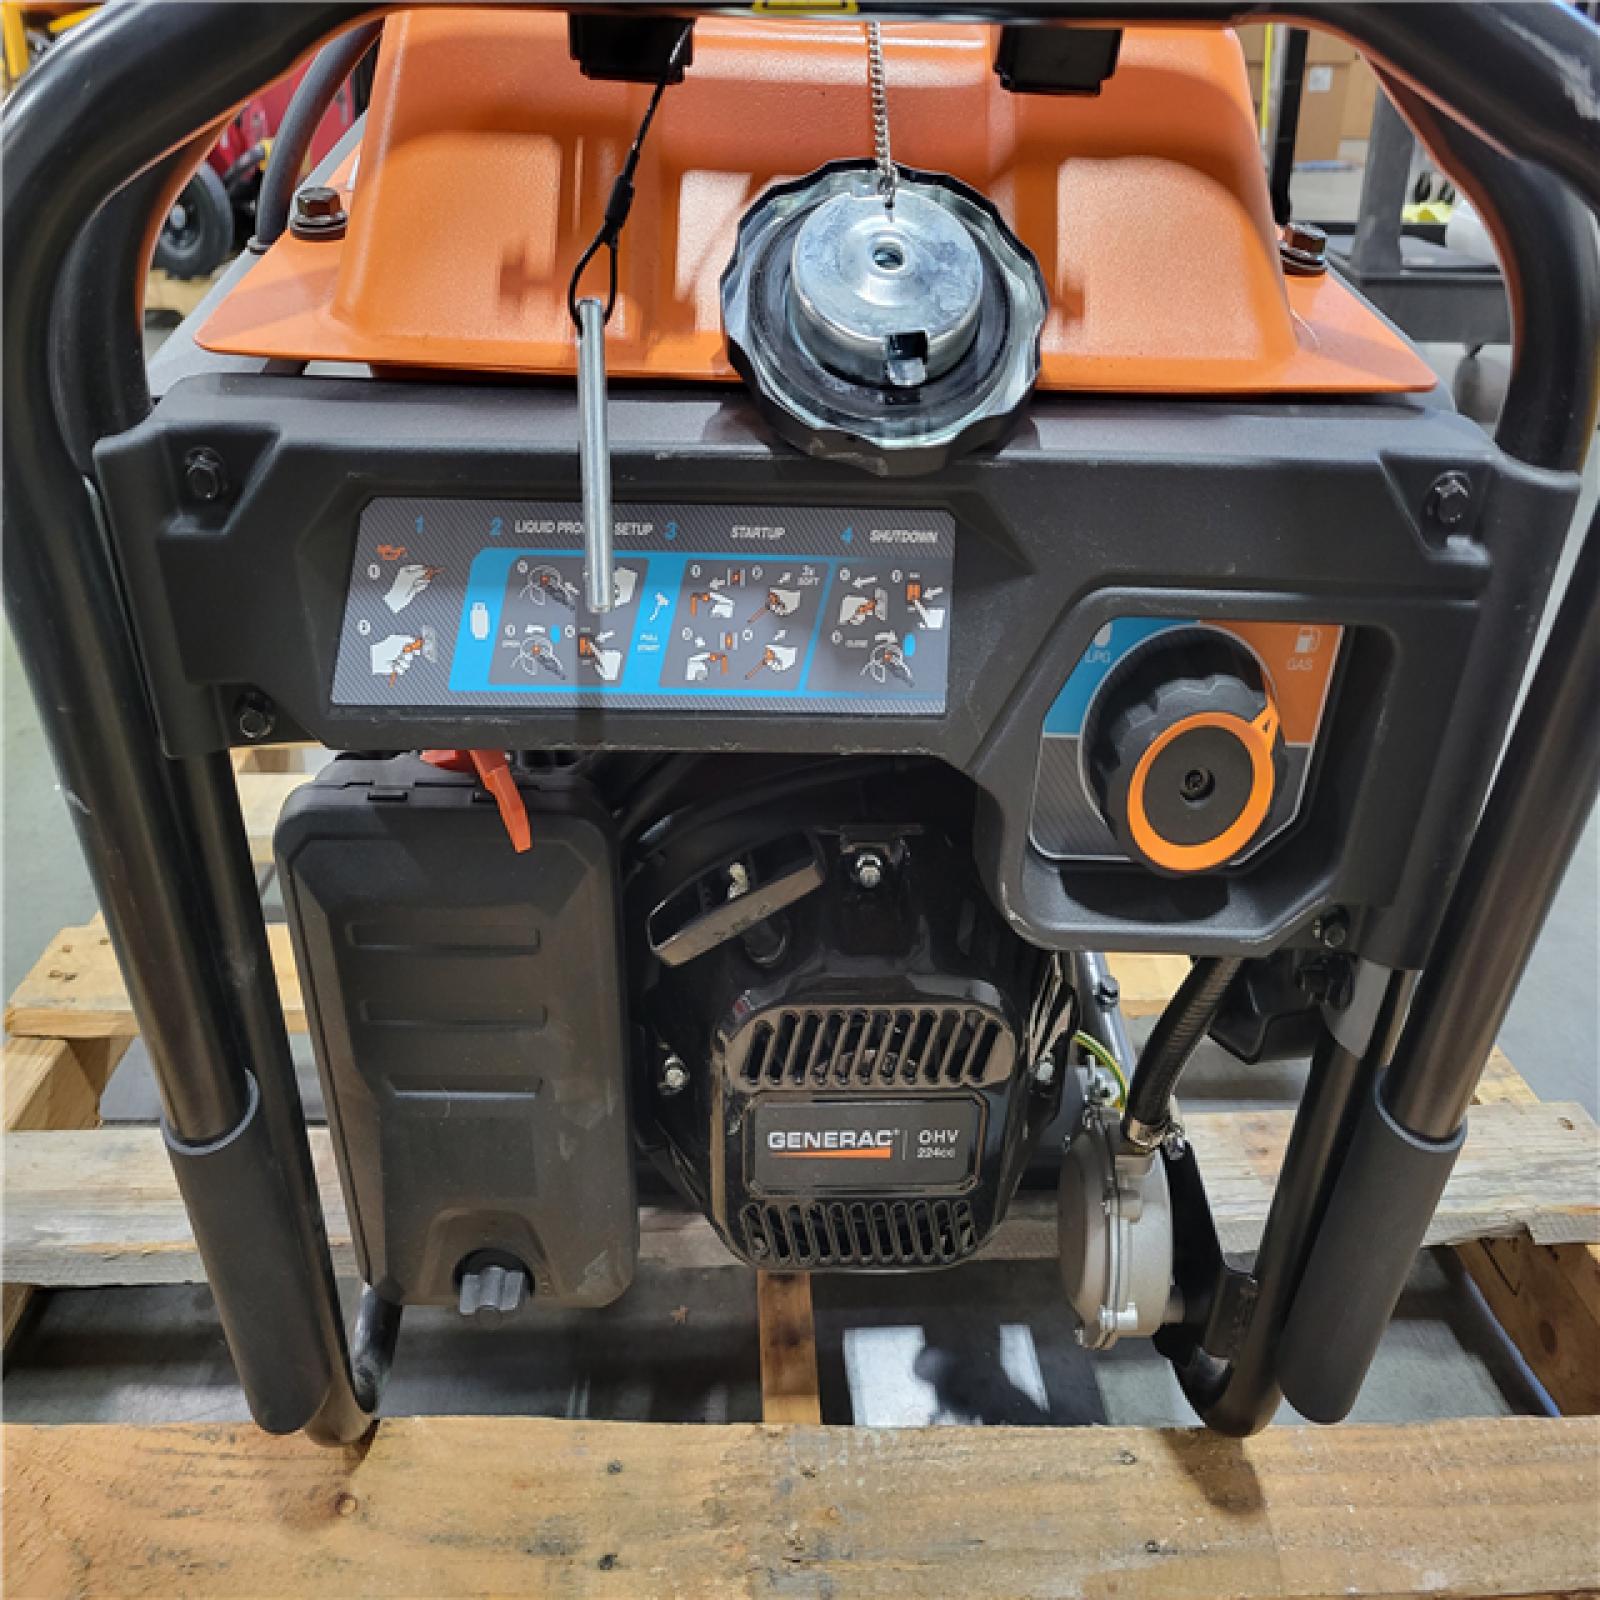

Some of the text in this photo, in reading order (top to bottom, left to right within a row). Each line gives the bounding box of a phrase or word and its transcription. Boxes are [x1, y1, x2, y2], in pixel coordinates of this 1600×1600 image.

[489, 516, 504, 537] 2
[514, 519, 556, 534] LIQUID
[614, 521, 654, 536] SETUP
[664, 521, 679, 541] 3
[730, 525, 786, 540] STARTUP
[840, 526, 854, 544] 4
[869, 529, 938, 544] SHUTDOWN
[1287, 658, 1313, 671] GAS
[768, 1130, 893, 1149] GENERAC
[918, 1129, 959, 1144] OHV
